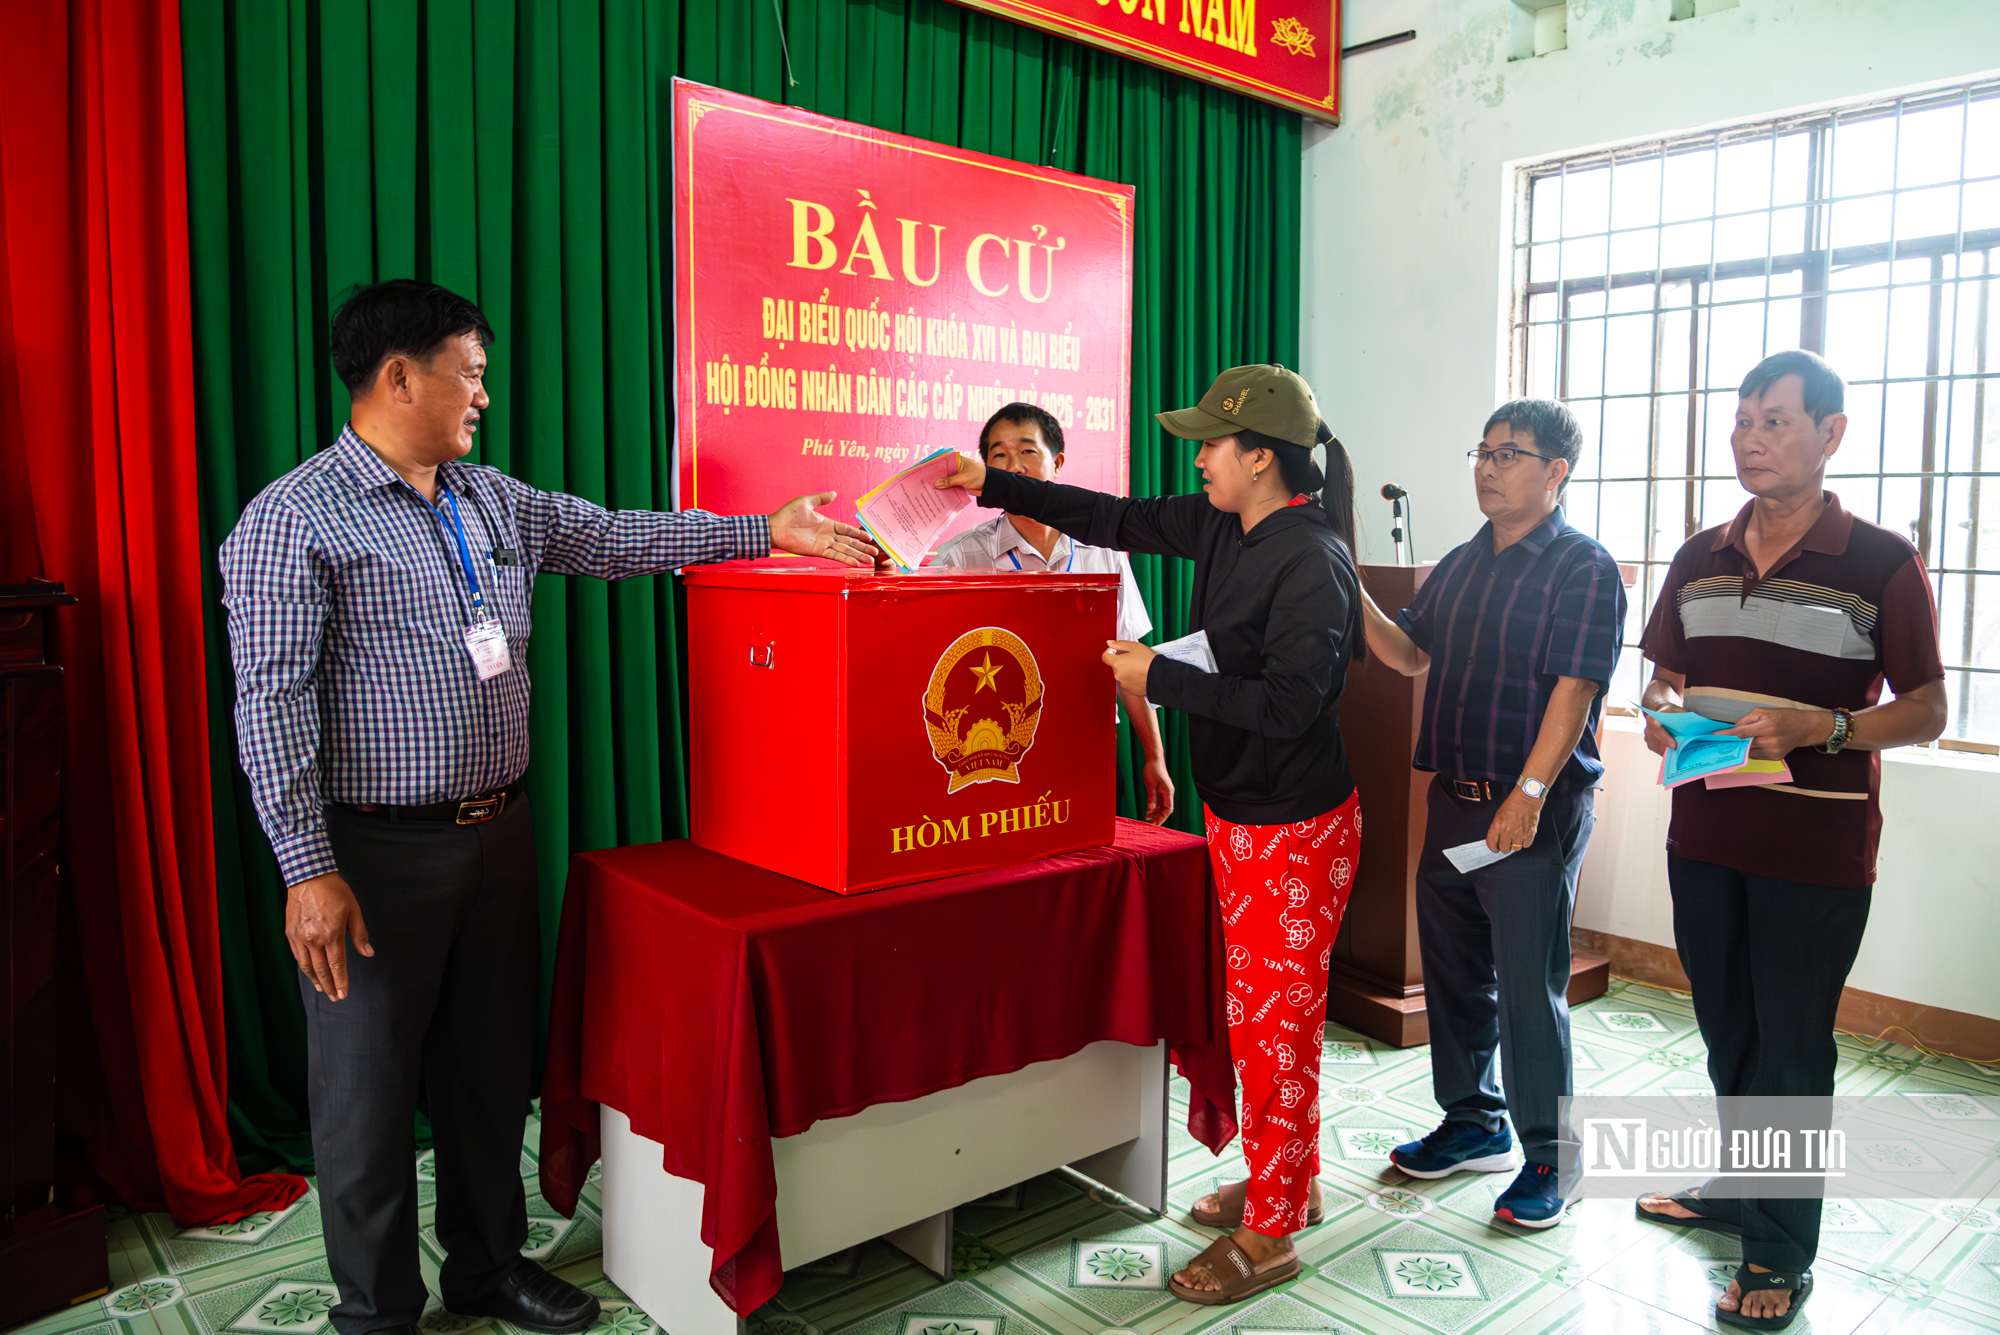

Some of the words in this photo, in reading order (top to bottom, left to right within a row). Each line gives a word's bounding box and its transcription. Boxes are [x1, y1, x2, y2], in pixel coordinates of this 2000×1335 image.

[785, 189, 946, 287] BẦU
[965, 224, 1066, 303] CỬ
[762, 296, 794, 350] ĐẠI
[799, 287, 840, 346] BIỂU
[845, 296, 890, 352] QUỐC
[895, 307, 922, 363] HỘI
[926, 312, 968, 359] KHÓA
[972, 323, 996, 361] XVI
[999, 319, 1019, 365] VÀ
[1022, 329, 1046, 375] ĐẠI
[1049, 320, 1081, 372] BIỂU
[706, 353, 740, 415] HỘI
[744, 351, 797, 410] ĐỒNG
[801, 363, 852, 414] NHÂN
[856, 367, 892, 416] DÂN
[895, 371, 928, 420] CÁC
[932, 368, 964, 421] CẤP
[1085, 395, 1116, 432] 2031
[1232, 387, 1251, 416] CHANEL
[801, 438, 834, 457] Phú
[839, 439, 870, 460] Yên,
[874, 442, 910, 463] ngày
[913, 444, 930, 460] 15
[891, 814, 972, 854] HÒM
[979, 789, 1071, 838] PHIẾU
[1312, 814, 1343, 848] CHANEL
[1227, 894, 1252, 927] CHANEL
[1251, 990, 1281, 1023] CHANEL
